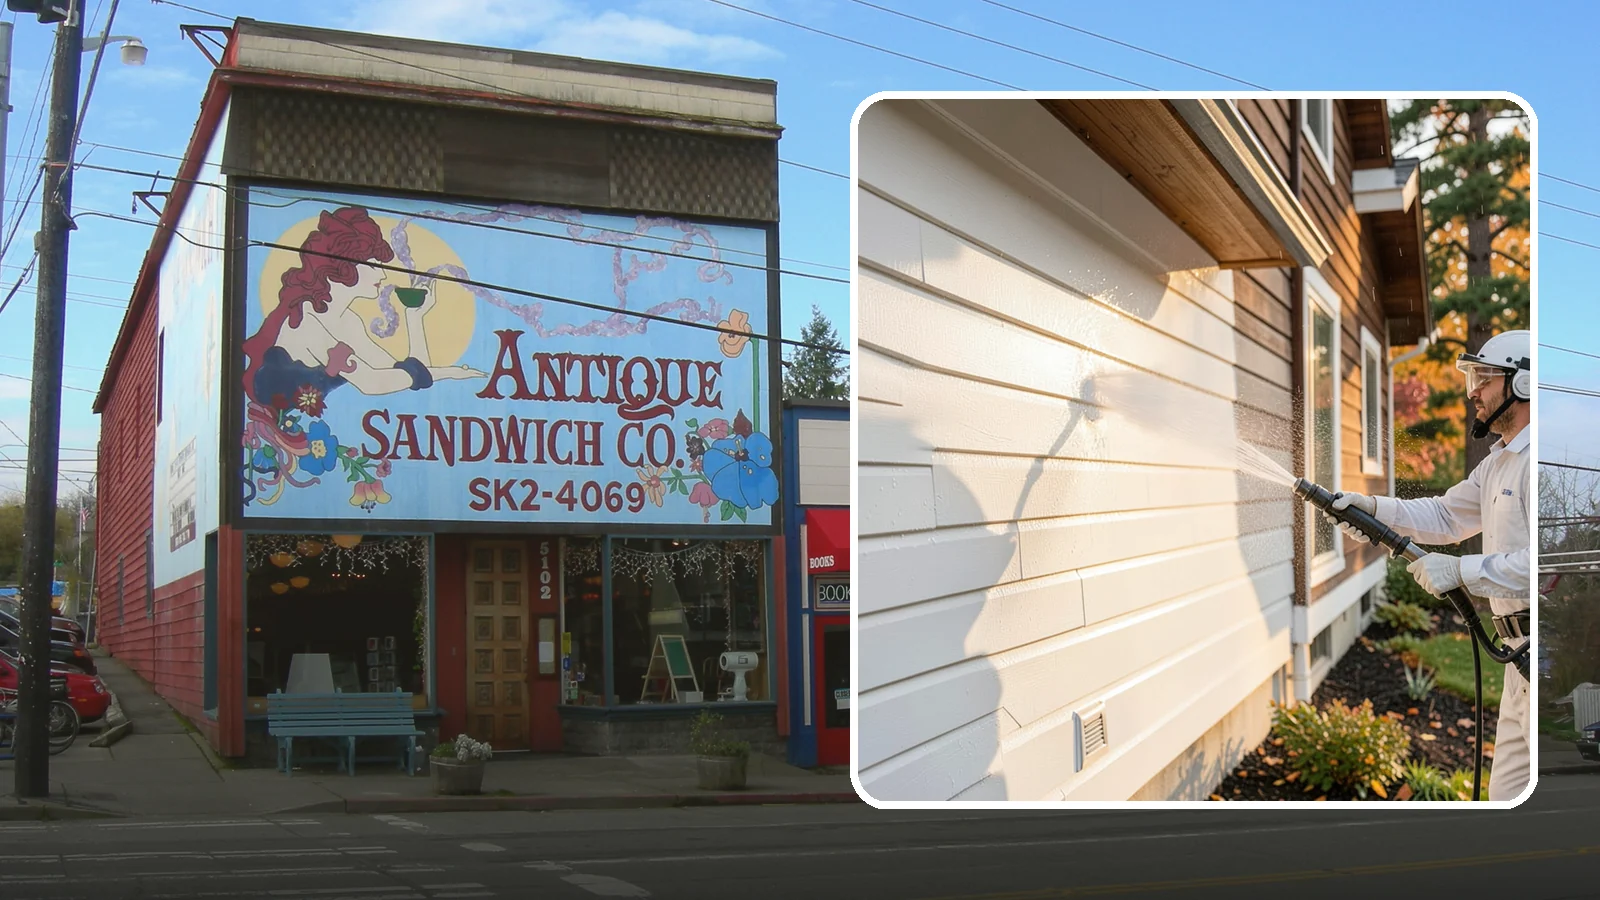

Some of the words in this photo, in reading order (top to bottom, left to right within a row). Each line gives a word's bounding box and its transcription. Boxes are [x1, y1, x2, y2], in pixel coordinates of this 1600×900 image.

[362, 409, 605, 467] SANDWICH
[617, 422, 686, 469] CO.
[468, 478, 646, 513] SK2-4069
[540, 542, 552, 600] 5102
[809, 555, 835, 569] BOOKS
